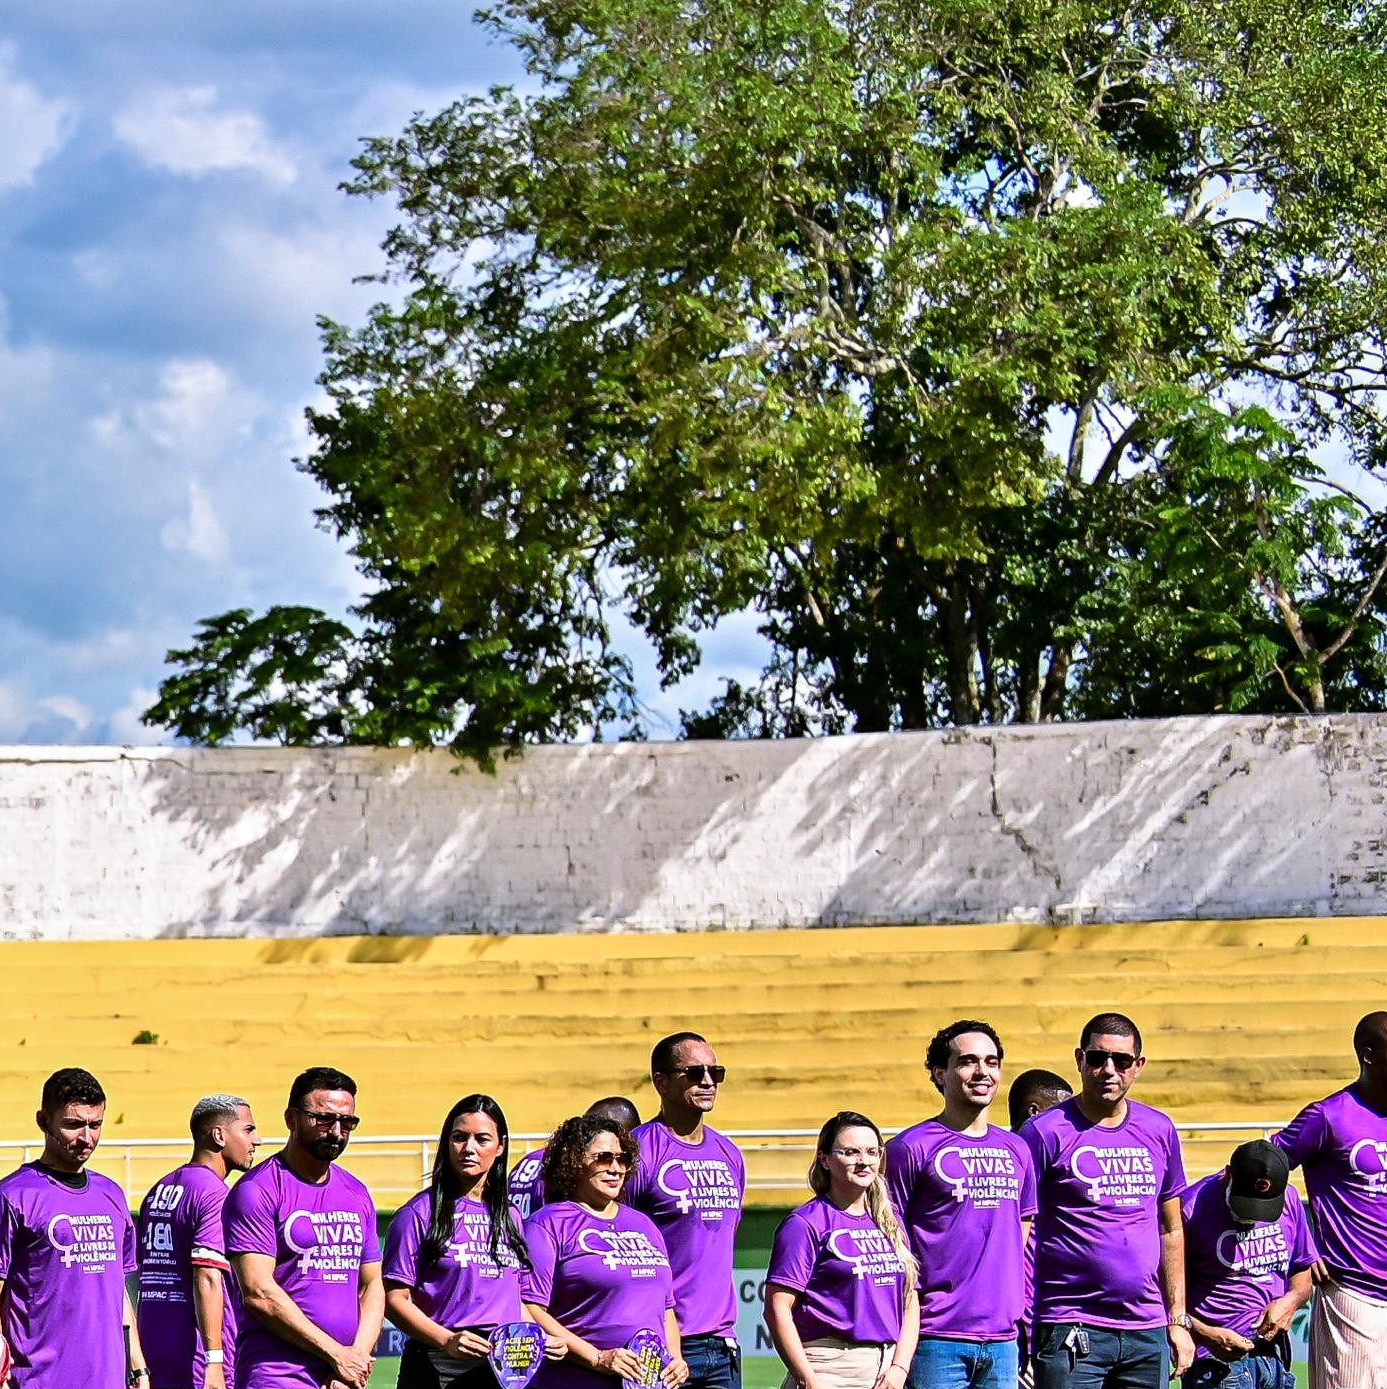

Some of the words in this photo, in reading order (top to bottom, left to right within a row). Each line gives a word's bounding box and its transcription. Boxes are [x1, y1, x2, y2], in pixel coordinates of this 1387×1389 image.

[958, 1148, 1010, 1158] MULHERES
[1098, 1148, 1149, 1157] MULHERES
[682, 1160, 727, 1170] MULHERES
[962, 1158, 1015, 1174] VIVAS
[1098, 1157, 1153, 1174] VIVAS
[685, 1170, 734, 1186] VIVAS
[150, 1184, 184, 1210] 190
[69, 1215, 111, 1226] MULHERES
[310, 1211, 361, 1224] MULHERES
[71, 1225, 115, 1241] VIVAS
[313, 1224, 363, 1245] VIVAS
[1236, 1223, 1282, 1242] MULHERES
[1238, 1234, 1287, 1258] VIVAS
